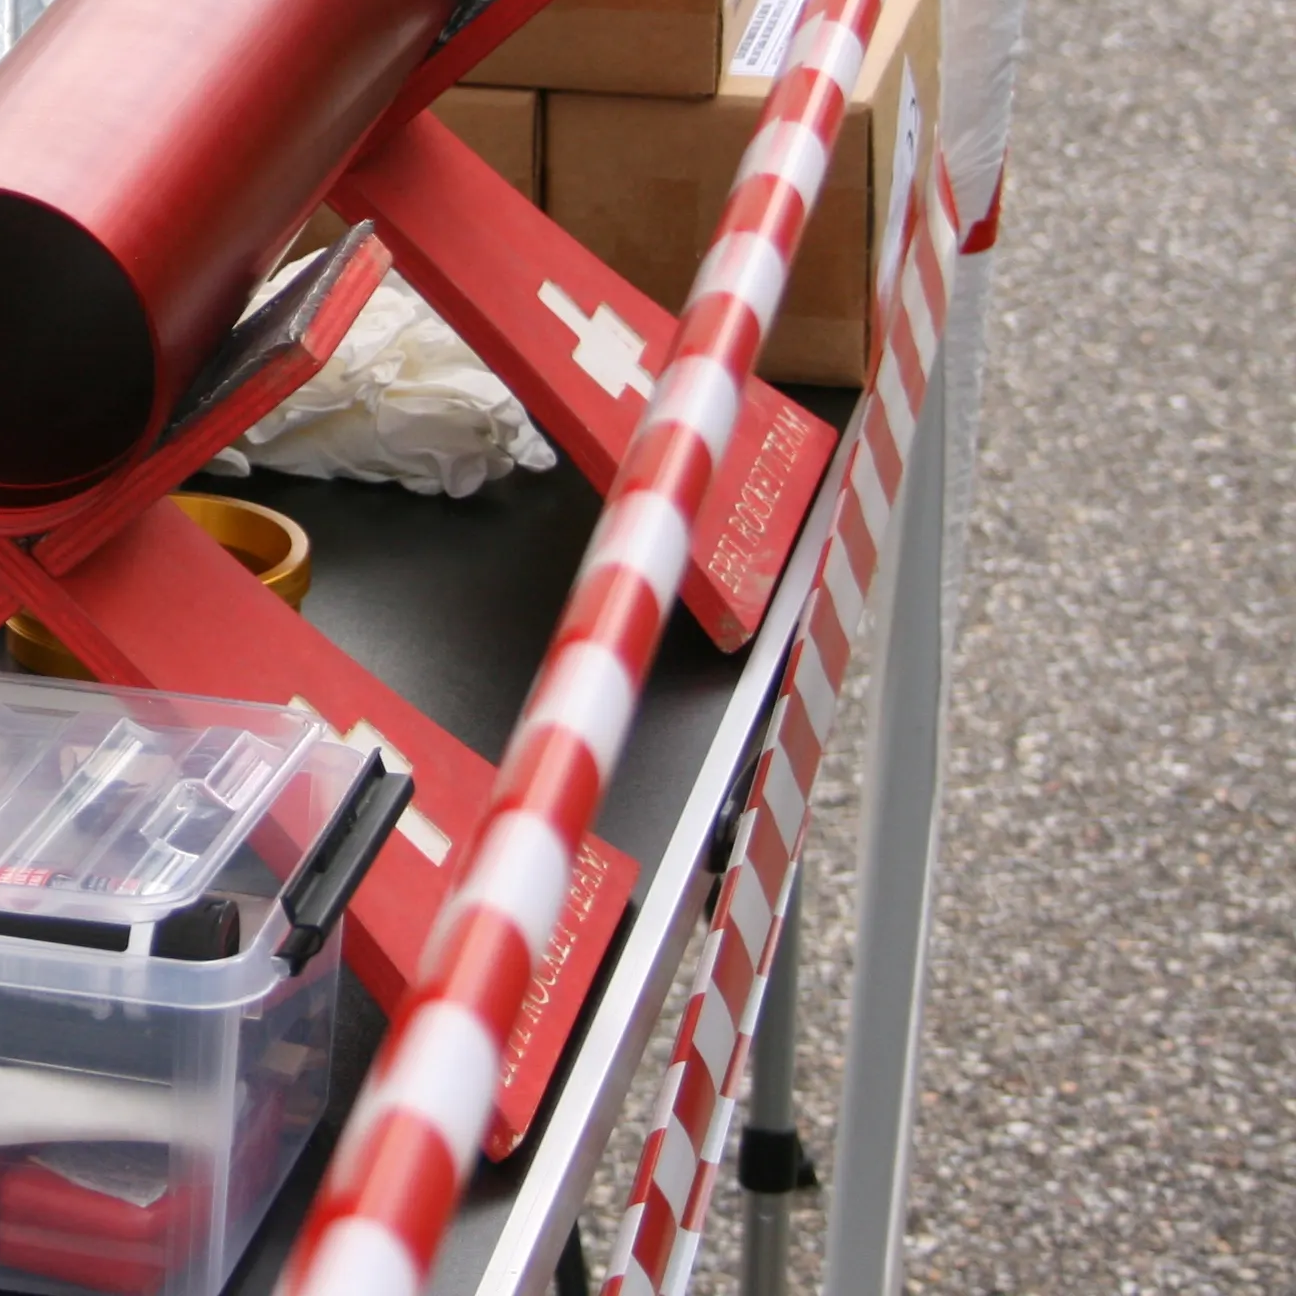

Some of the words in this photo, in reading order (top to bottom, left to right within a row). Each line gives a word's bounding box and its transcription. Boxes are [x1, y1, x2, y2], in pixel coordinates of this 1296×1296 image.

[761, 405, 810, 473] TEAM
[728, 455, 785, 547] ROCKET
[708, 532, 754, 593] EPFL
